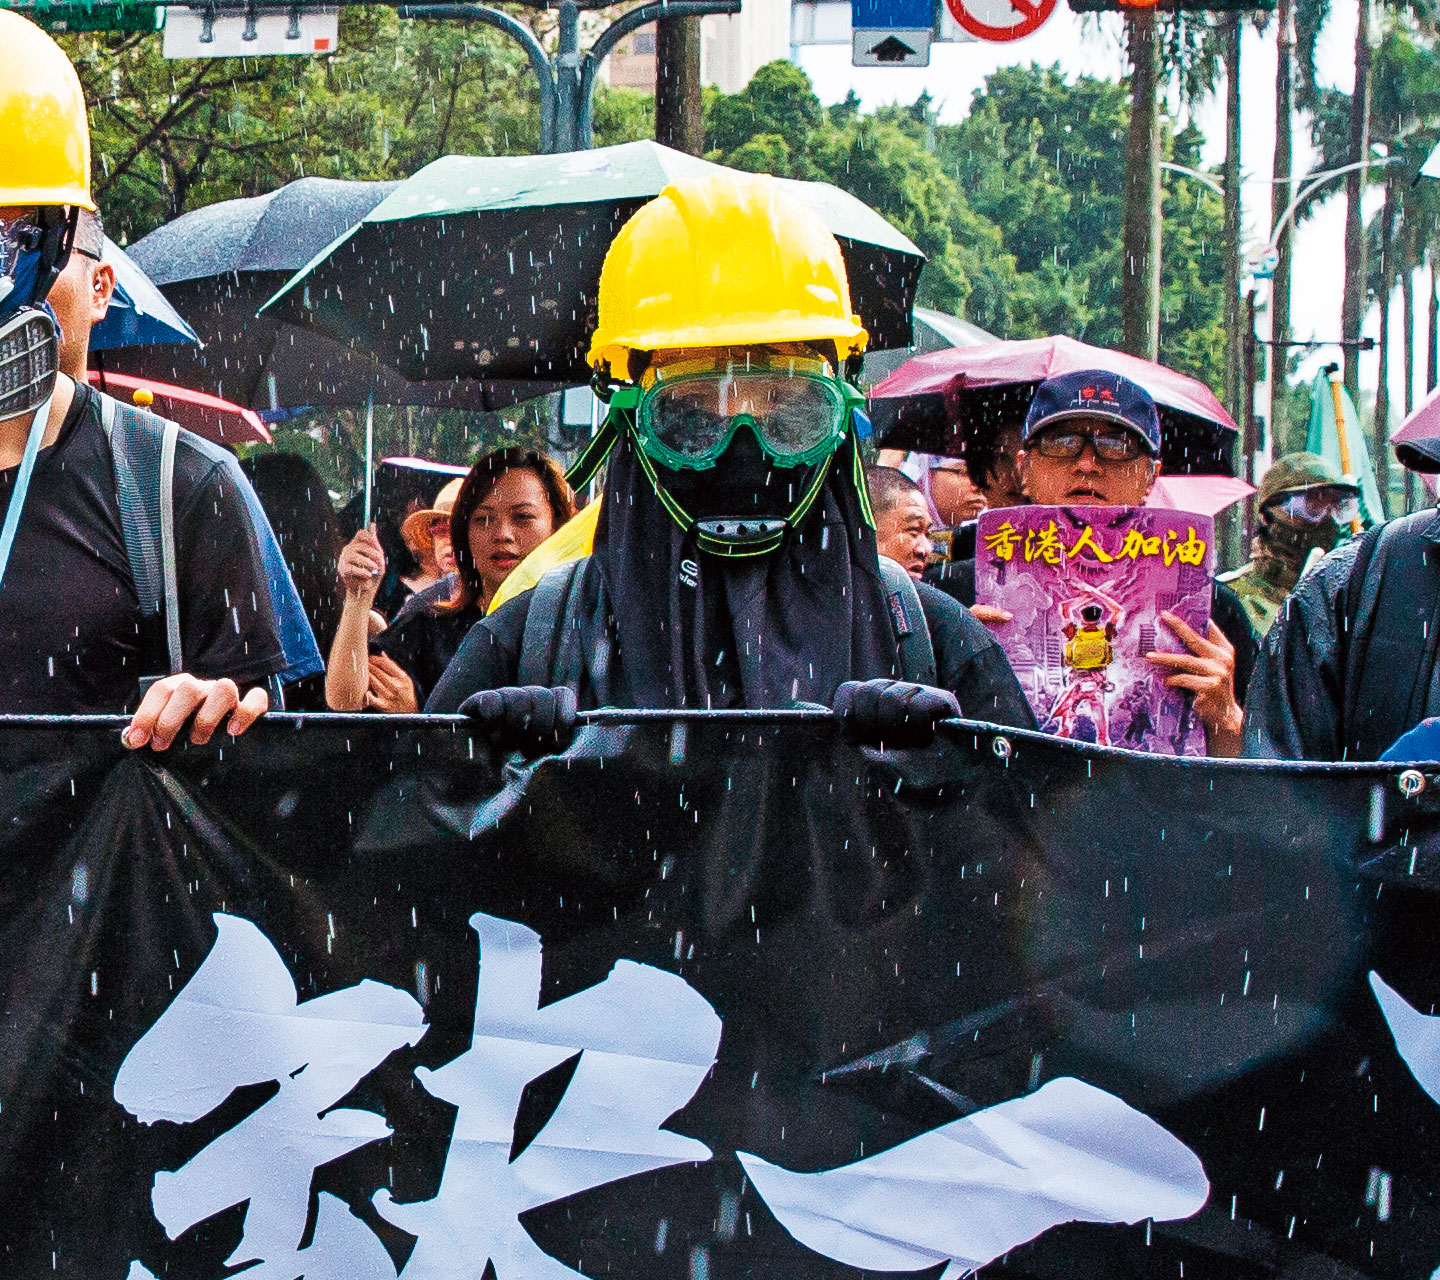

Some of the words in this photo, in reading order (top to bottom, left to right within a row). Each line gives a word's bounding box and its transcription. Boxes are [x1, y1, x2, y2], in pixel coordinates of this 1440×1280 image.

[984, 520, 1207, 567] 香港人加油
